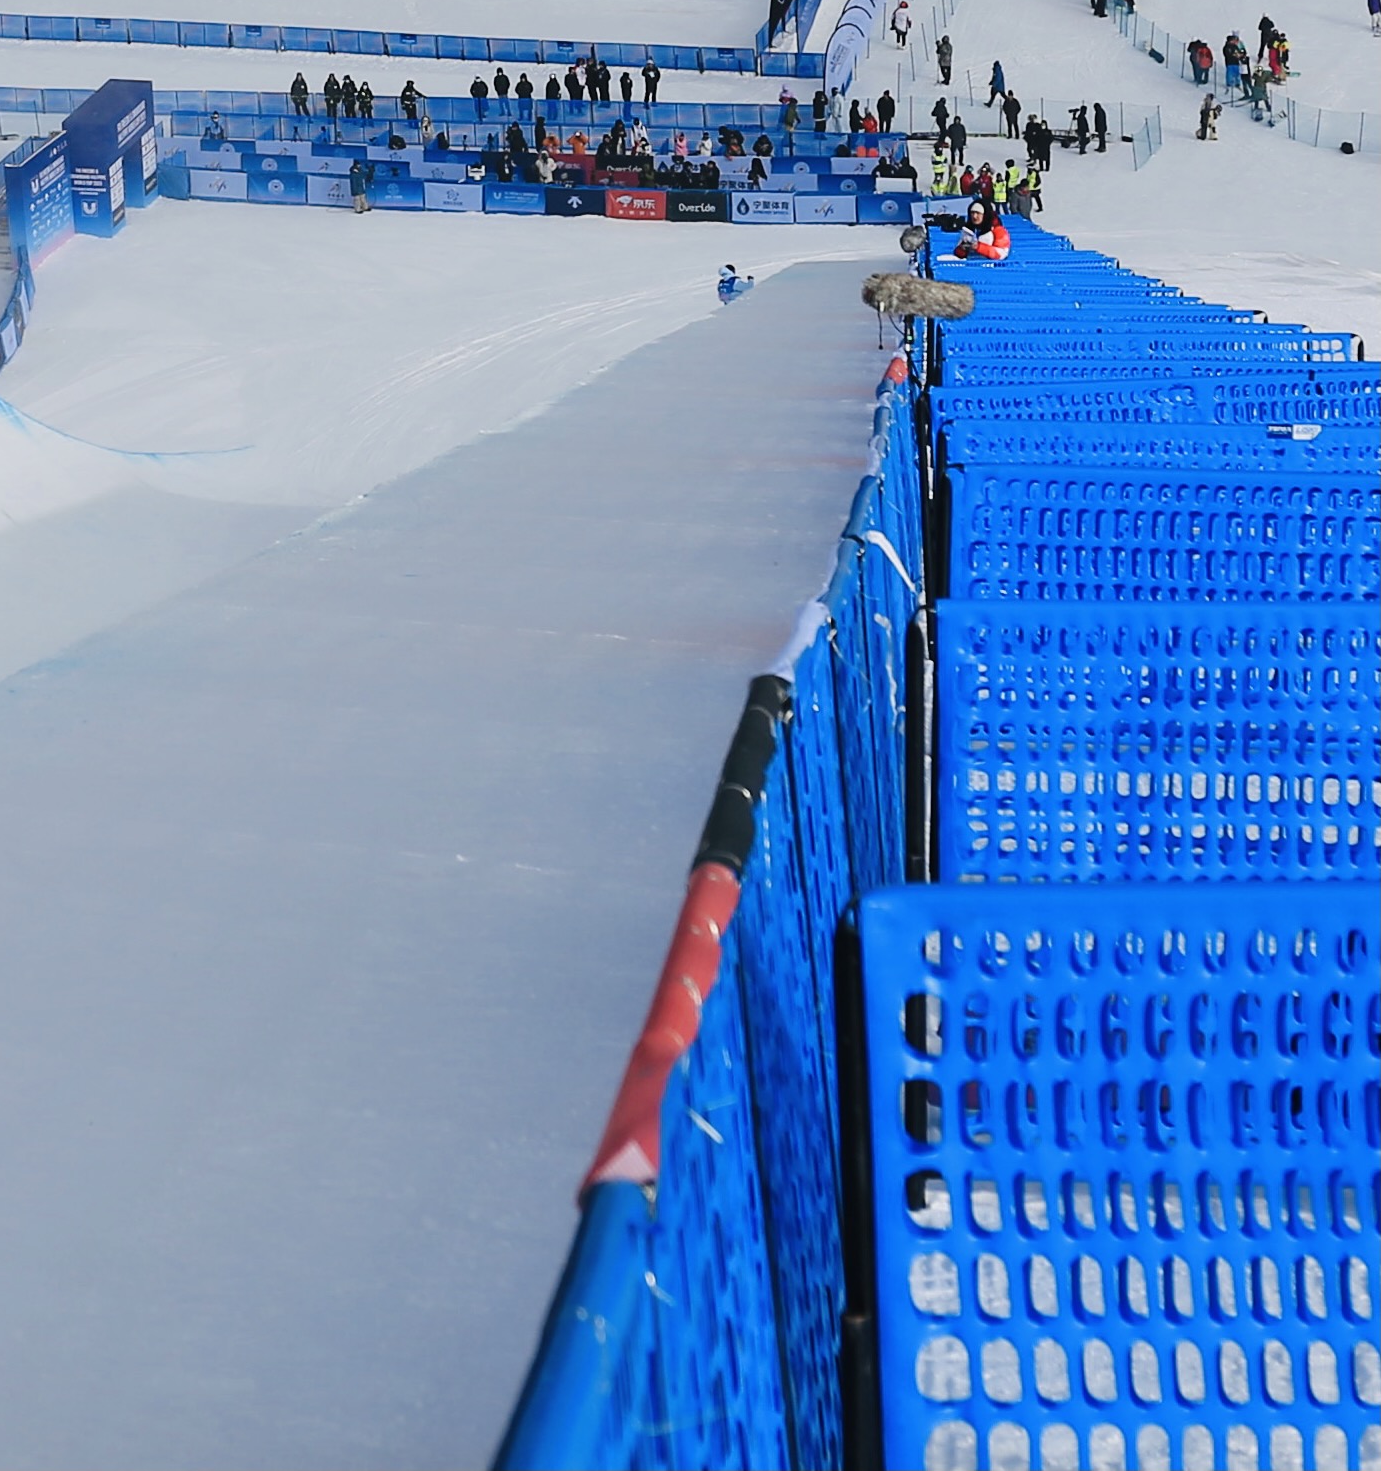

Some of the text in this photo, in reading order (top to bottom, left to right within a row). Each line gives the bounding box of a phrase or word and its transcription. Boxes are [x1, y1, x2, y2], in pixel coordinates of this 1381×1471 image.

[633, 199, 655, 209] 京东
[753, 200, 789, 210] 宁聚体育
